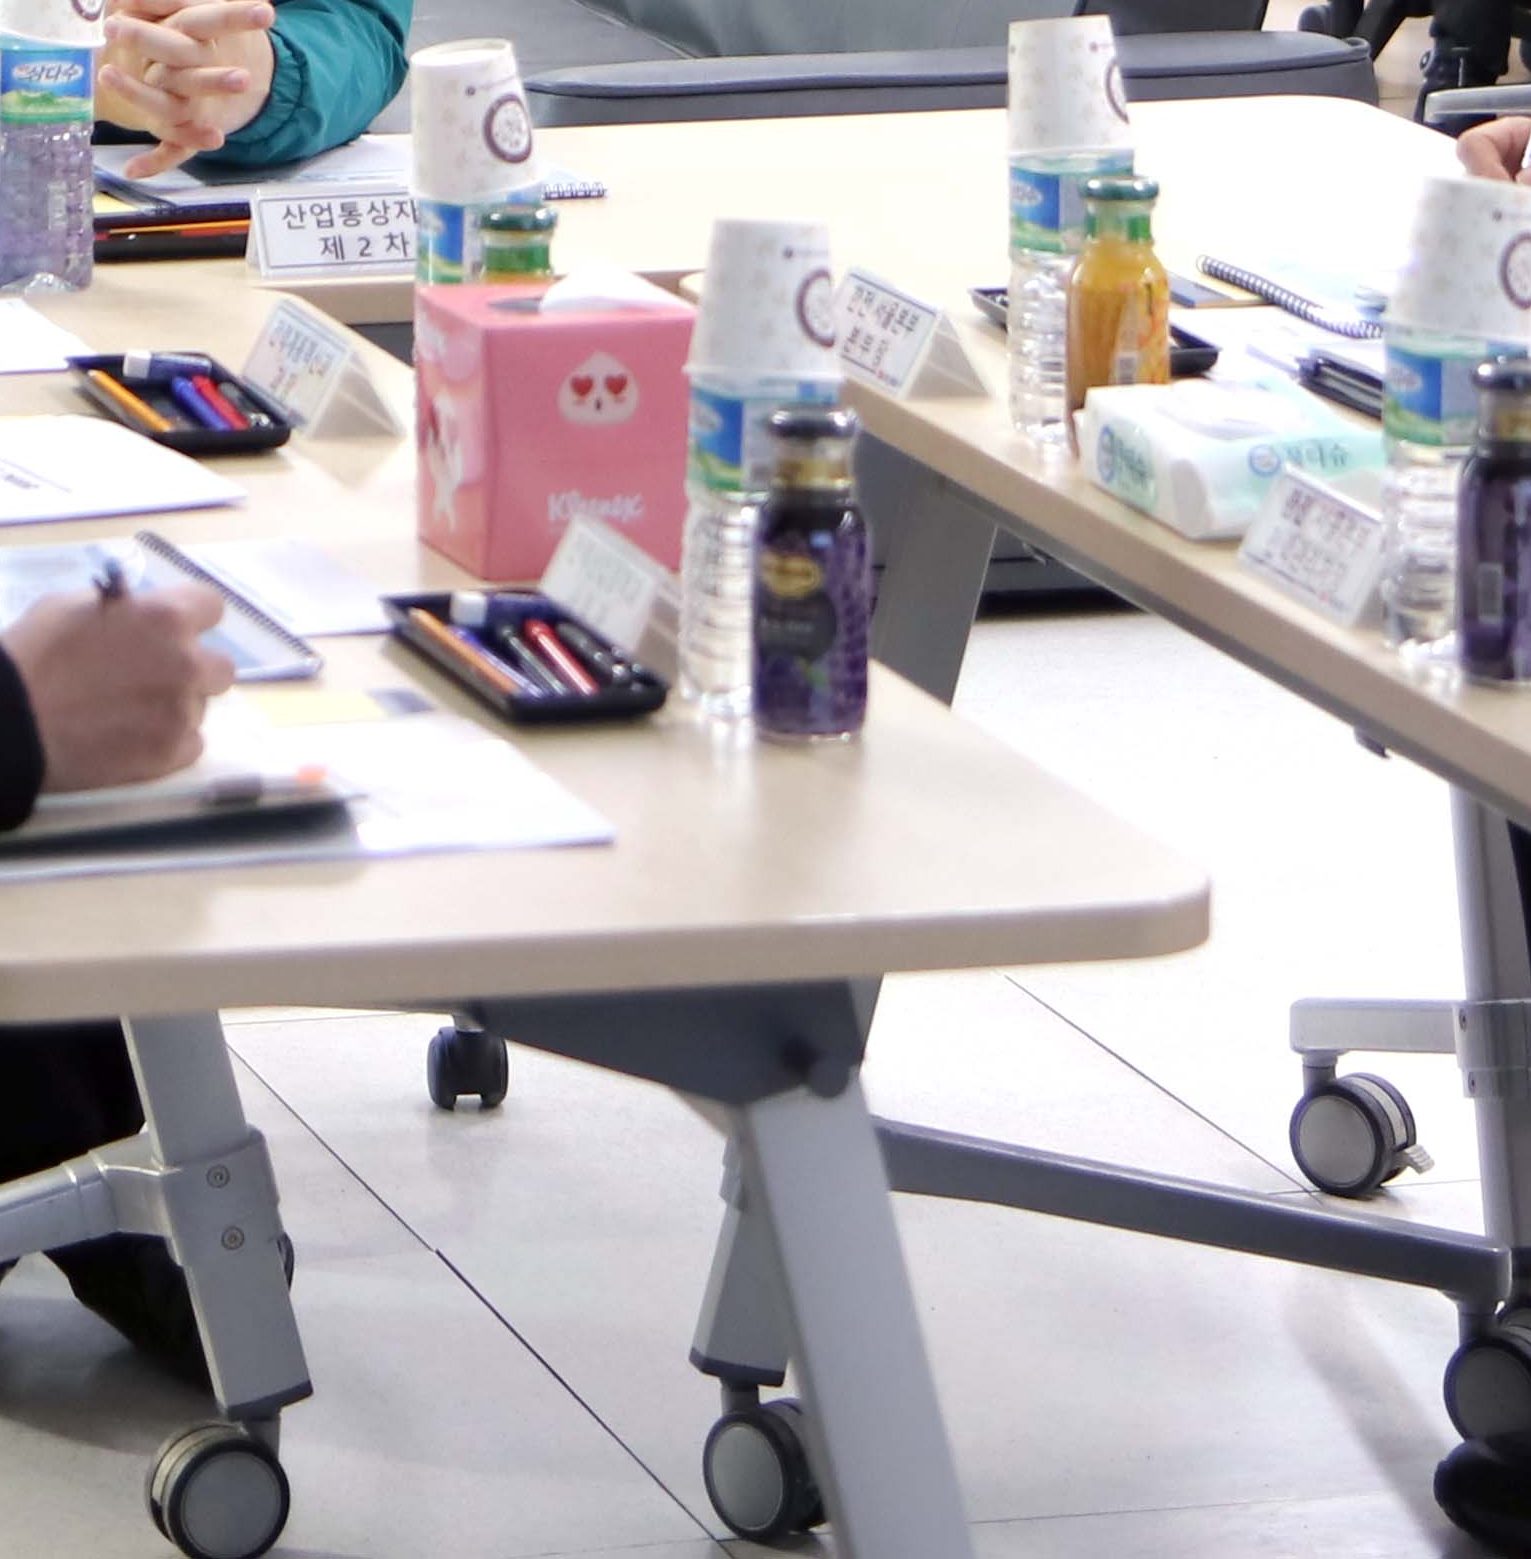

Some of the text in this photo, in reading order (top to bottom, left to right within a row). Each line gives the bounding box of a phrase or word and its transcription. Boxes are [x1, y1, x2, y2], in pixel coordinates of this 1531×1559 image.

[281, 198, 418, 231] 산업통상자
[320, 231, 410, 261] 제 2 차
